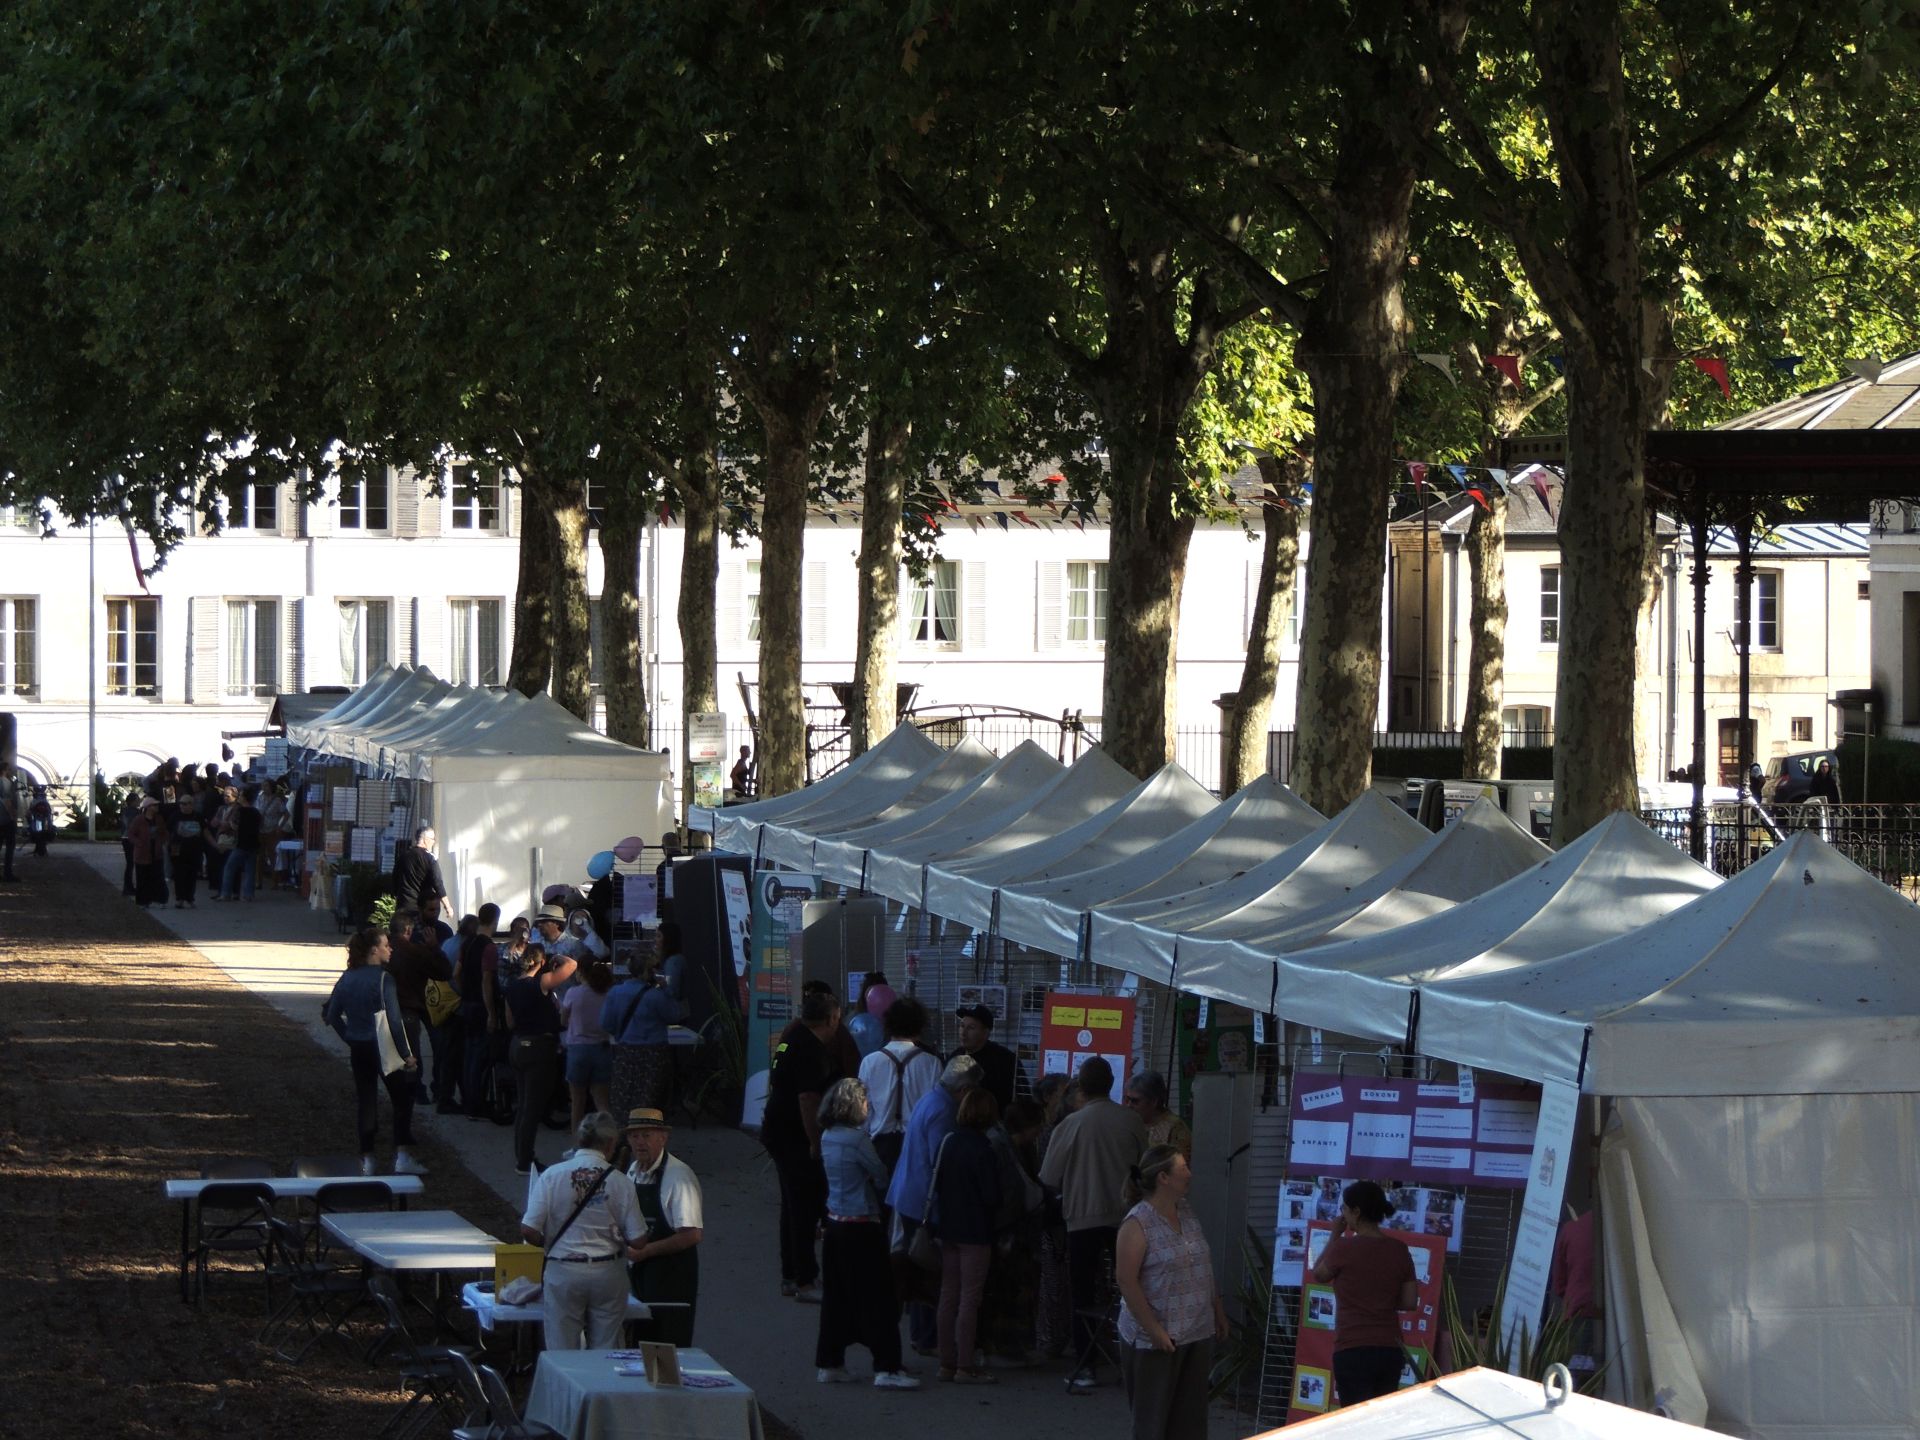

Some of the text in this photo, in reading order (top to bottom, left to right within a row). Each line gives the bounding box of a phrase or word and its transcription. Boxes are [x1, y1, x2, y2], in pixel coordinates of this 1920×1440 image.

[1304, 1090, 1340, 1102] SENEGAL
[1357, 1131, 1405, 1139] HANDICAPS
[1302, 1139, 1337, 1147] ENFANTS
